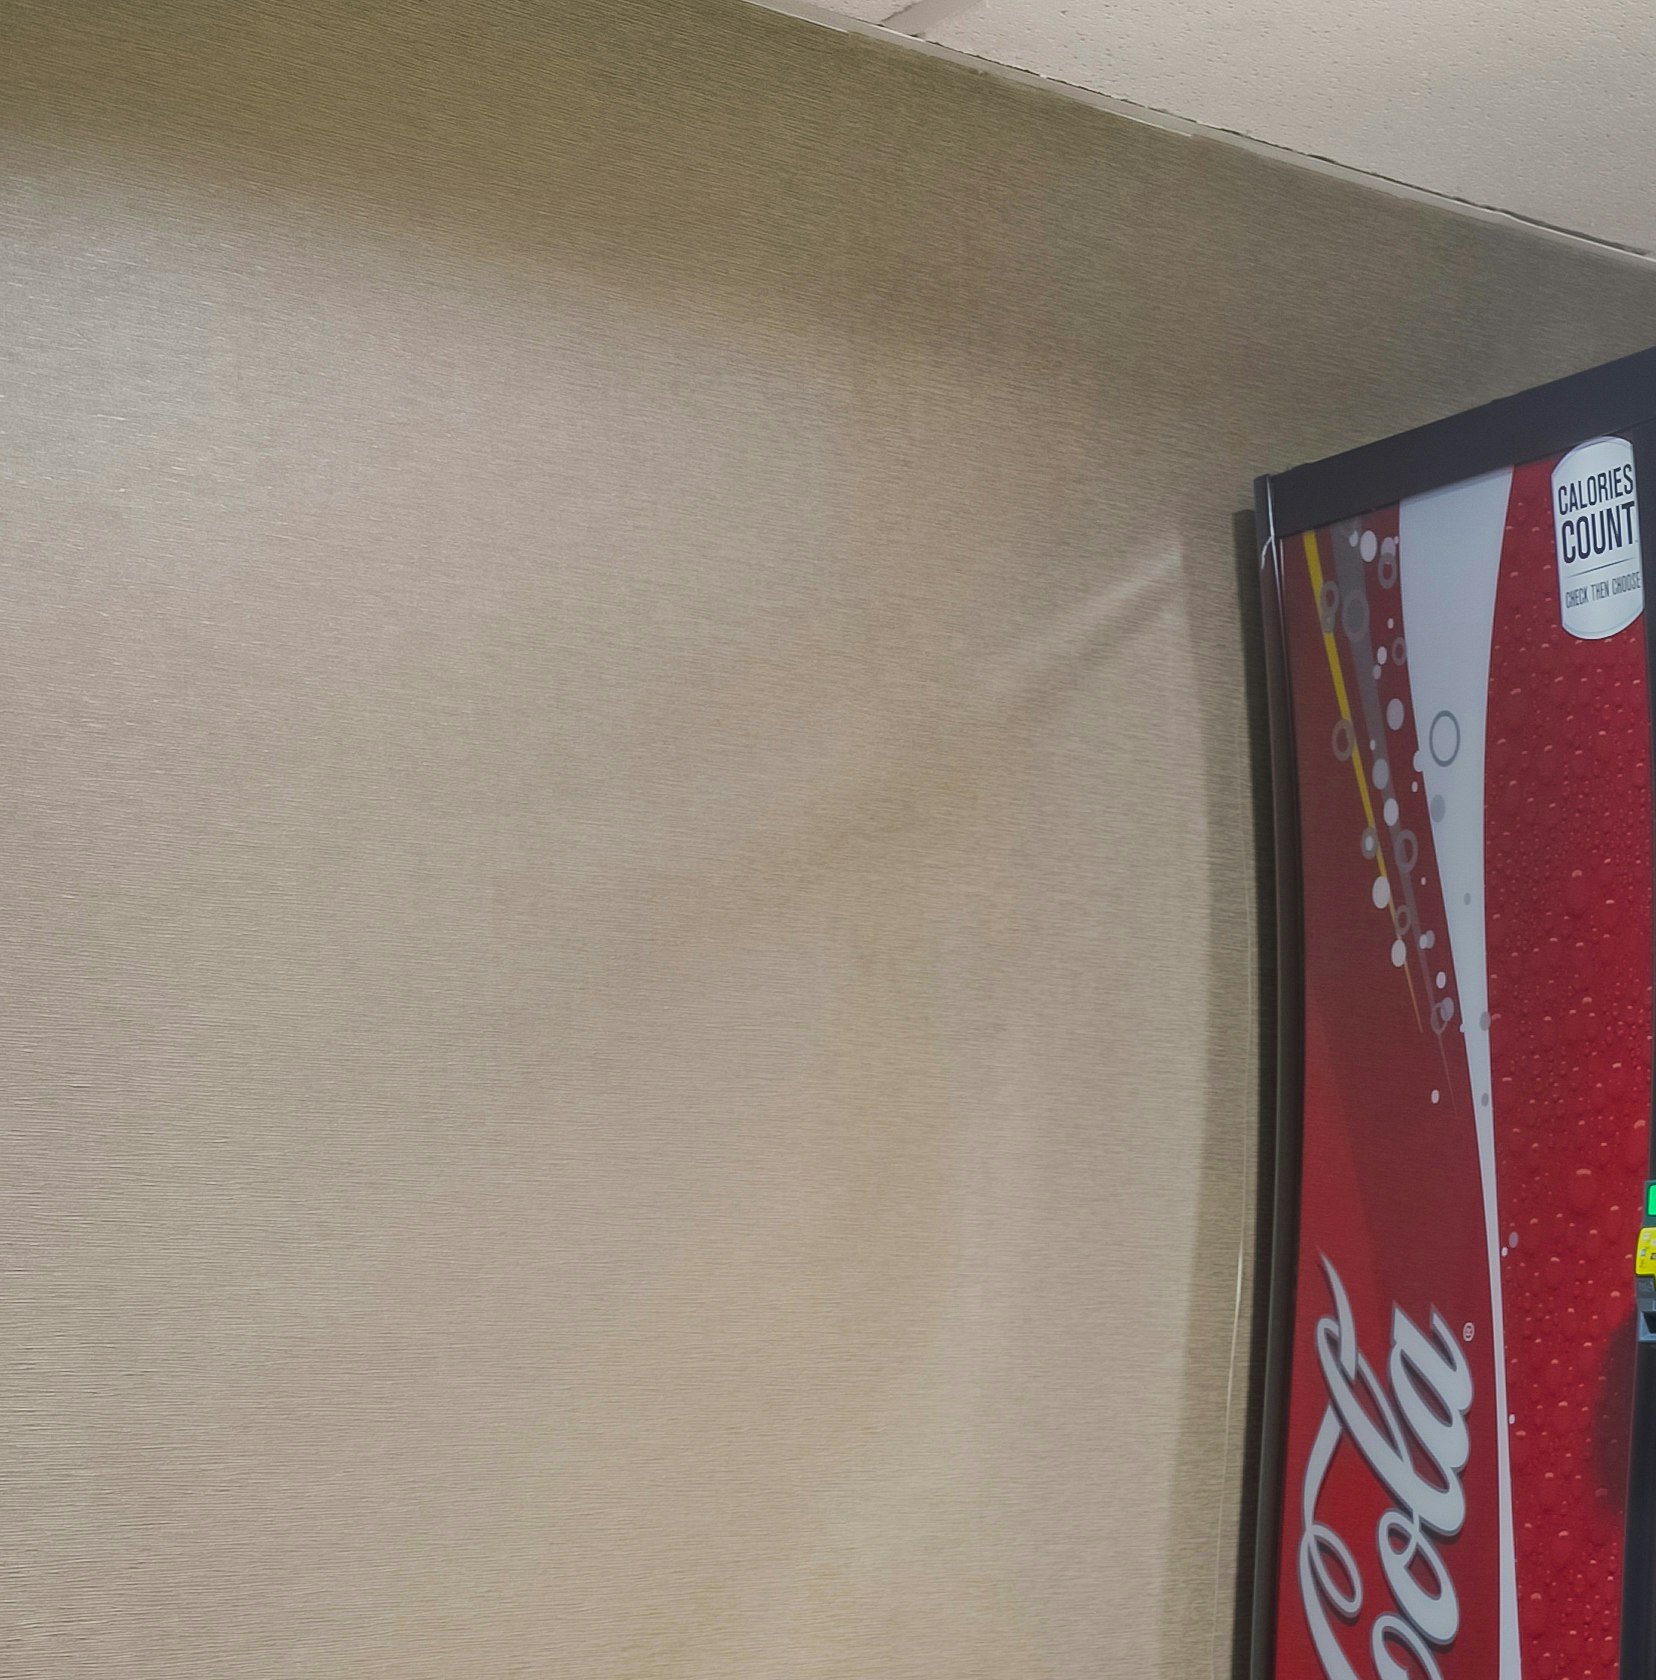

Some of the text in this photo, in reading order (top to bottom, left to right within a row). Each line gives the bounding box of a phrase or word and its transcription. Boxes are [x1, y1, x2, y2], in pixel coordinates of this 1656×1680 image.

[1558, 463, 1634, 516] CALORIES
[1561, 500, 1635, 564] COUNT
[1566, 571, 1641, 609] CHECK THEN CHOOSE
